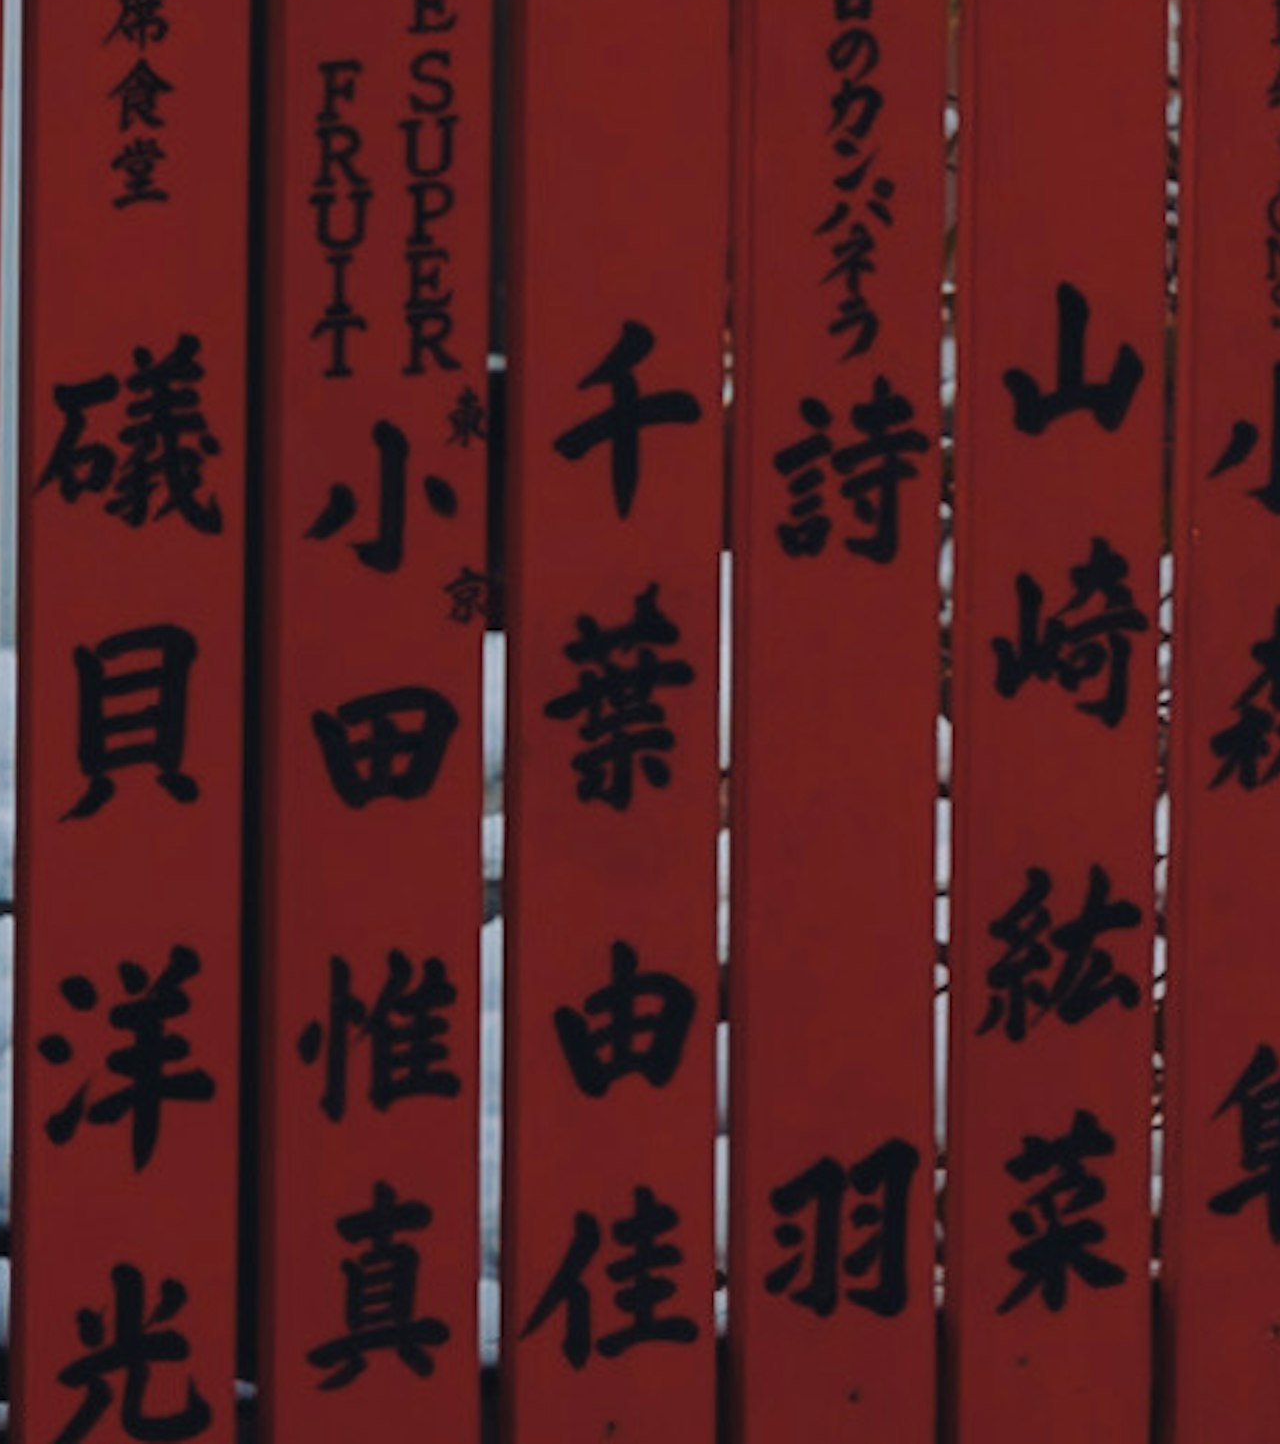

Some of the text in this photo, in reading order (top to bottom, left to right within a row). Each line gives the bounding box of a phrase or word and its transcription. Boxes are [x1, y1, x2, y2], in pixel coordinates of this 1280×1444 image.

[309, 59, 373, 378] FRUIT
[398, 50, 462, 376] SUPER
[297, 418, 461, 1391] 小田惟真
[519, 319, 701, 1369] 千葉由佳
[976, 283, 1148, 1315] 山崎紘菜
